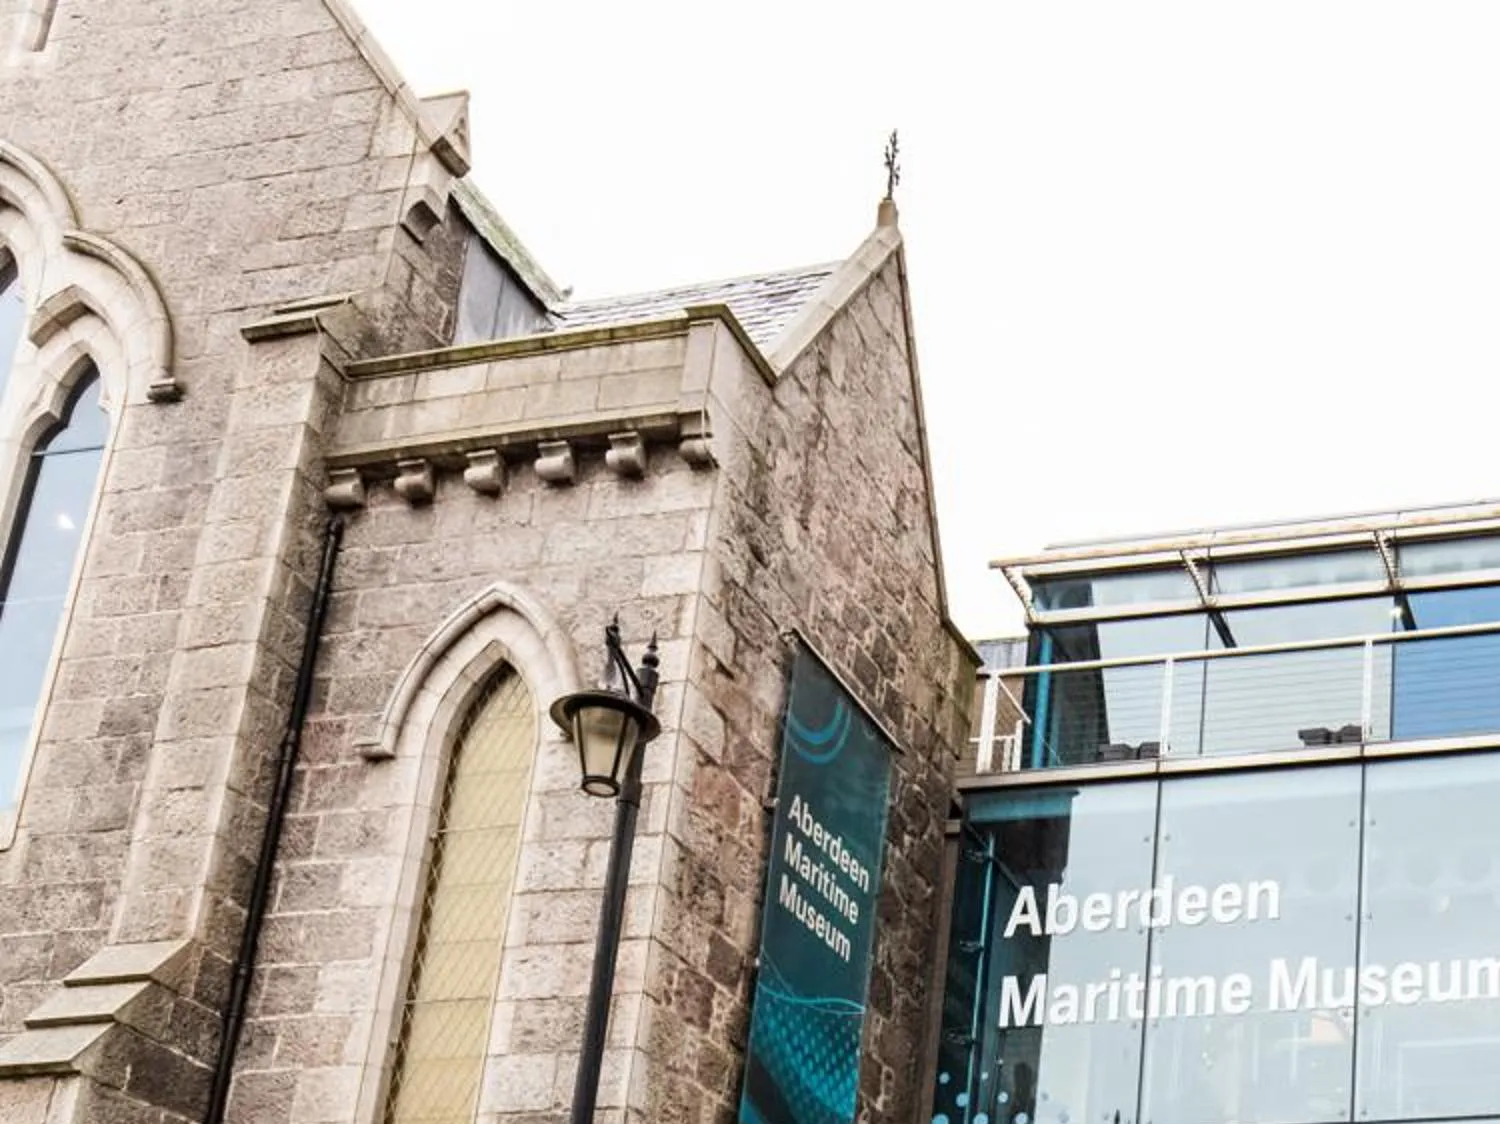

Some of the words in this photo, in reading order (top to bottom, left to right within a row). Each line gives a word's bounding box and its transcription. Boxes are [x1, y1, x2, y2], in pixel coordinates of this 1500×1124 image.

[783, 832, 859, 925] Maritime
[787, 793, 870, 893] Aberdeen
[779, 873, 851, 963] Museum
[1003, 875, 1281, 938] Aberdeen
[998, 964, 1252, 1028] Maritime
